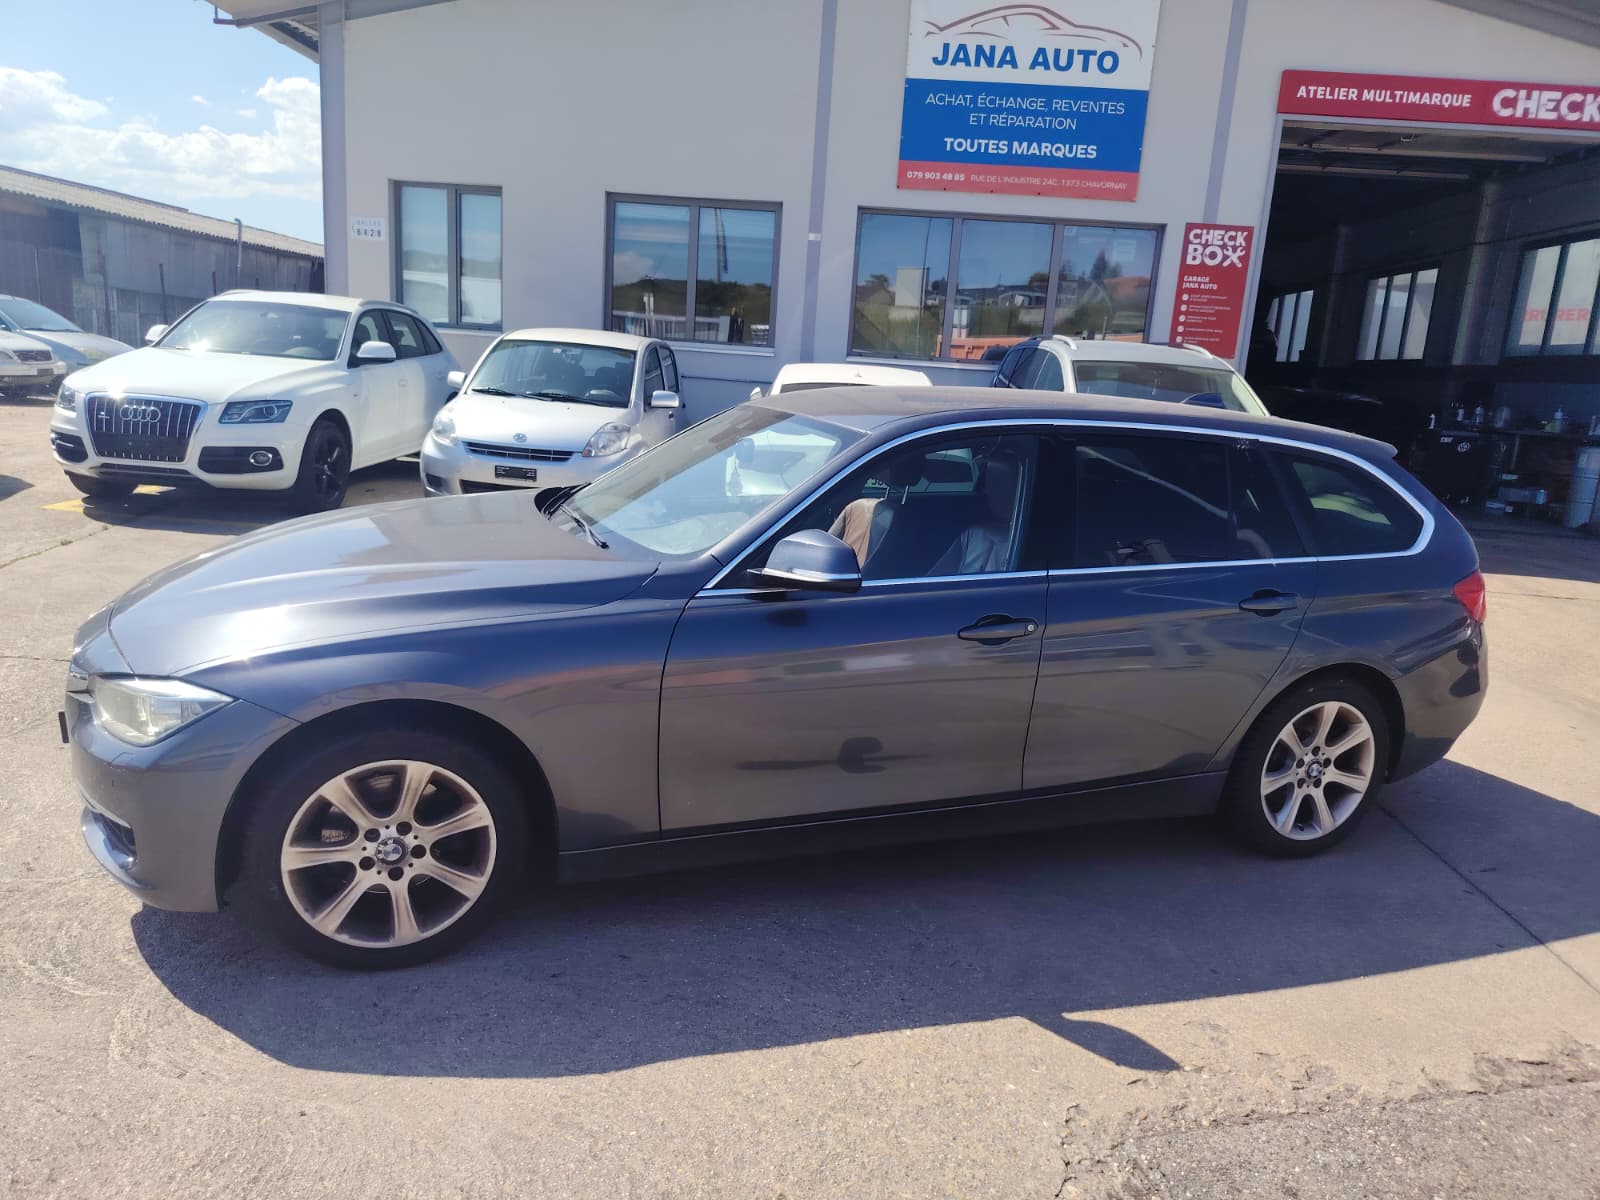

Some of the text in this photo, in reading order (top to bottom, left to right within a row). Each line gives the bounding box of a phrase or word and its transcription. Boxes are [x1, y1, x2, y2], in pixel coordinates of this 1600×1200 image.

[931, 42, 1120, 75] JANA AUTO
[925, 93, 1125, 115] ACHAT, ÉCHANGE, REVENTES
[1296, 85, 1472, 108] ATELIER MULTIMARQUE
[1491, 88, 1600, 122] CHECK
[969, 112, 1078, 131] ET RÉPARATION
[944, 137, 1097, 159] TOUTES MARQUES
[906, 170, 923, 179] 079
[924, 172, 941, 181] 903
[970, 174, 985, 183] RUE
[986, 175, 997, 183] DE
[1188, 229, 1248, 246] CHECK
[1186, 243, 1246, 268] BOX
